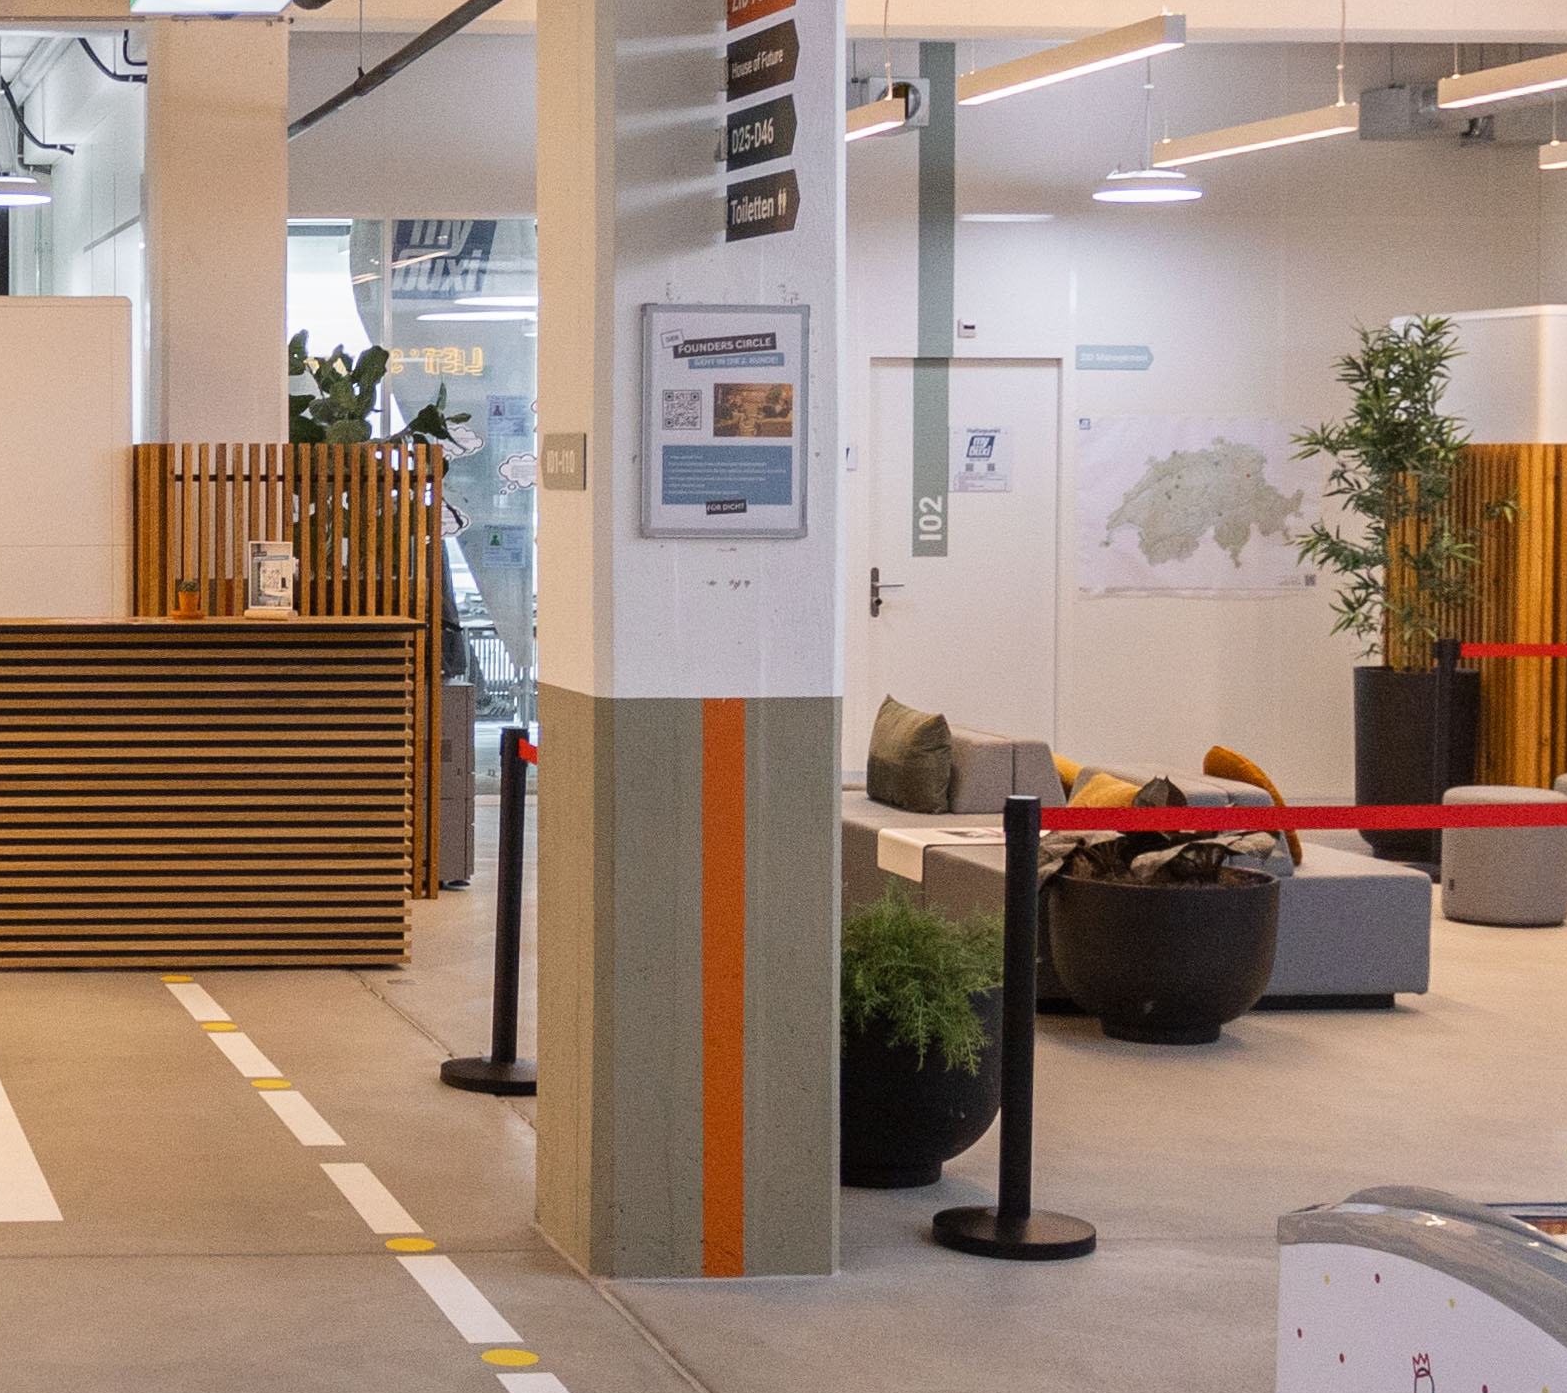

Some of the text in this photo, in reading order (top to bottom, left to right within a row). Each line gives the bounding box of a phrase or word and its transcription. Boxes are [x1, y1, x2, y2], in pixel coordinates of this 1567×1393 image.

[731, 49, 784, 79] House of Future
[732, 117, 774, 154] D25-D46
[731, 195, 774, 225] Toiletten
[678, 337, 772, 354] FOUNDERS CIRCLE
